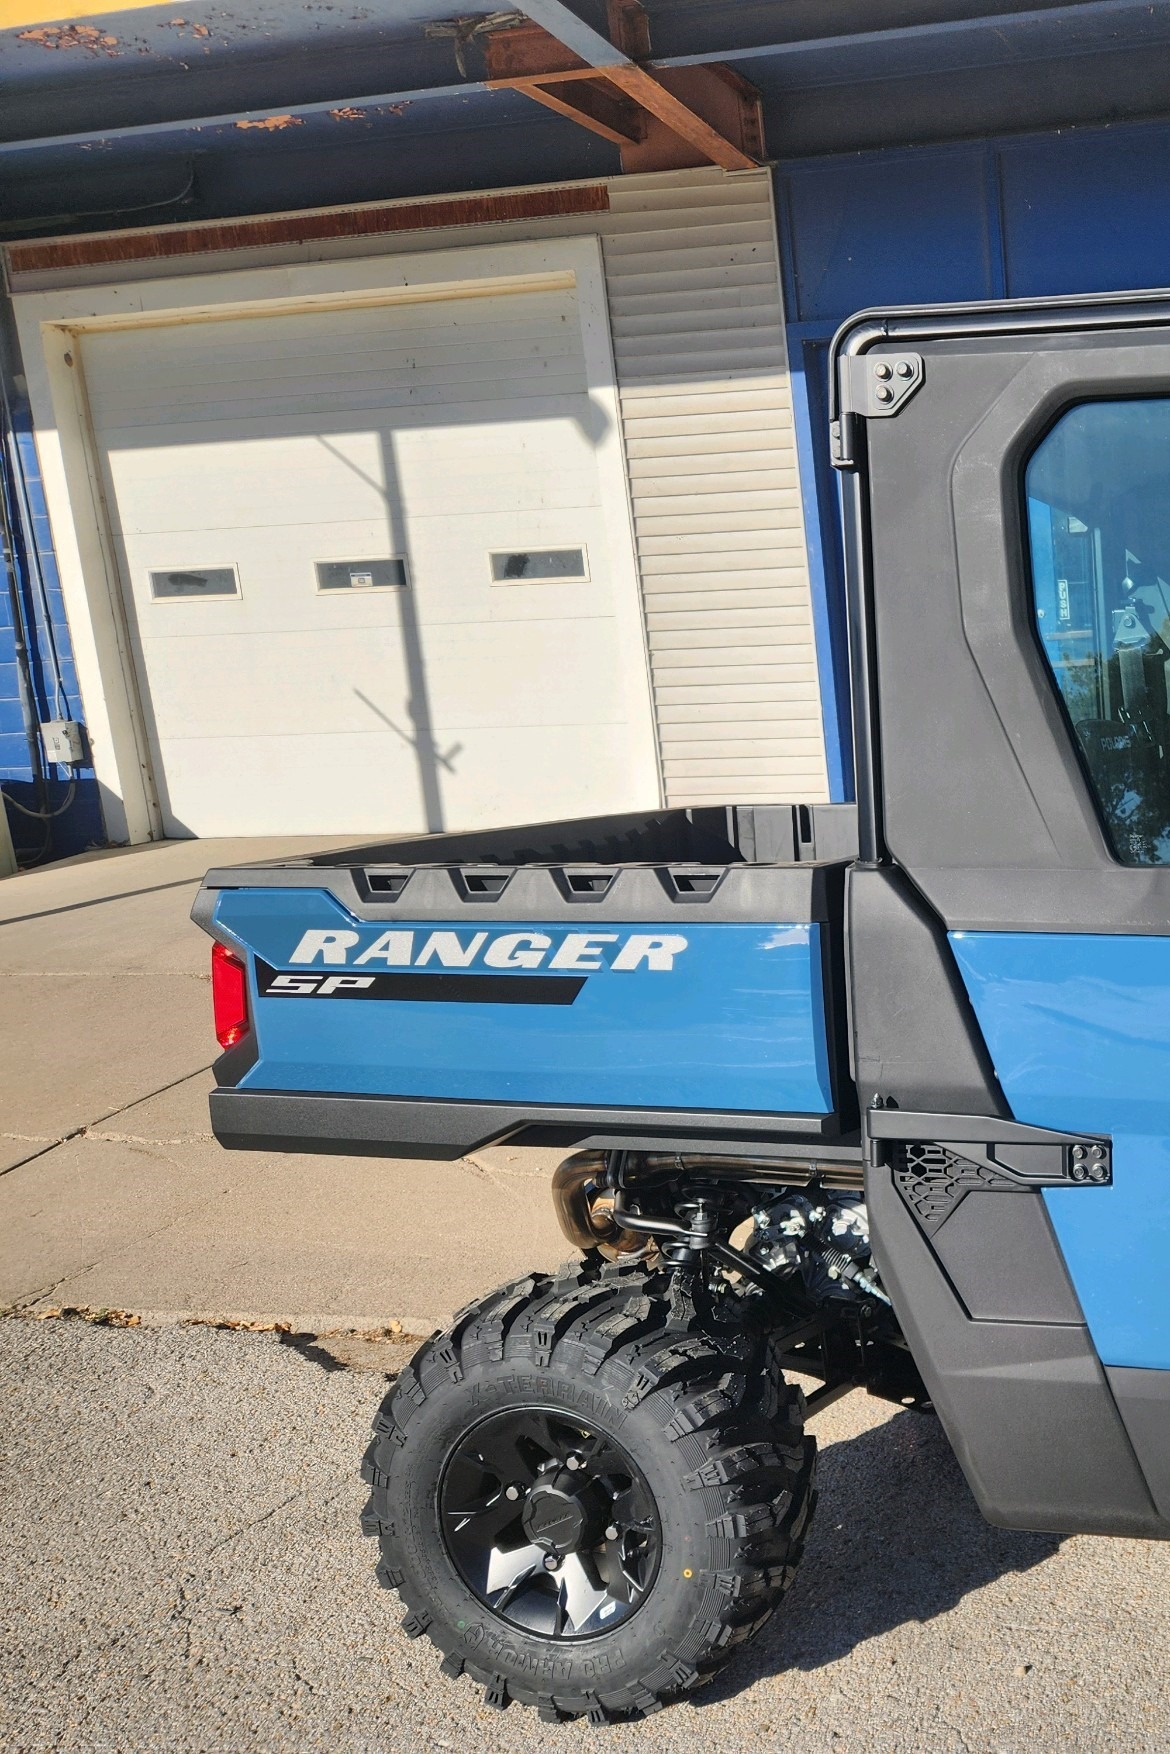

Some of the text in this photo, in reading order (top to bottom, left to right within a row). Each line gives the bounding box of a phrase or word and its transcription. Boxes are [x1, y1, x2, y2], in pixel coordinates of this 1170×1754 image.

[1058, 582, 1068, 618] PUSH
[288, 929, 689, 971] RANGER
[265, 975, 376, 995] SP
